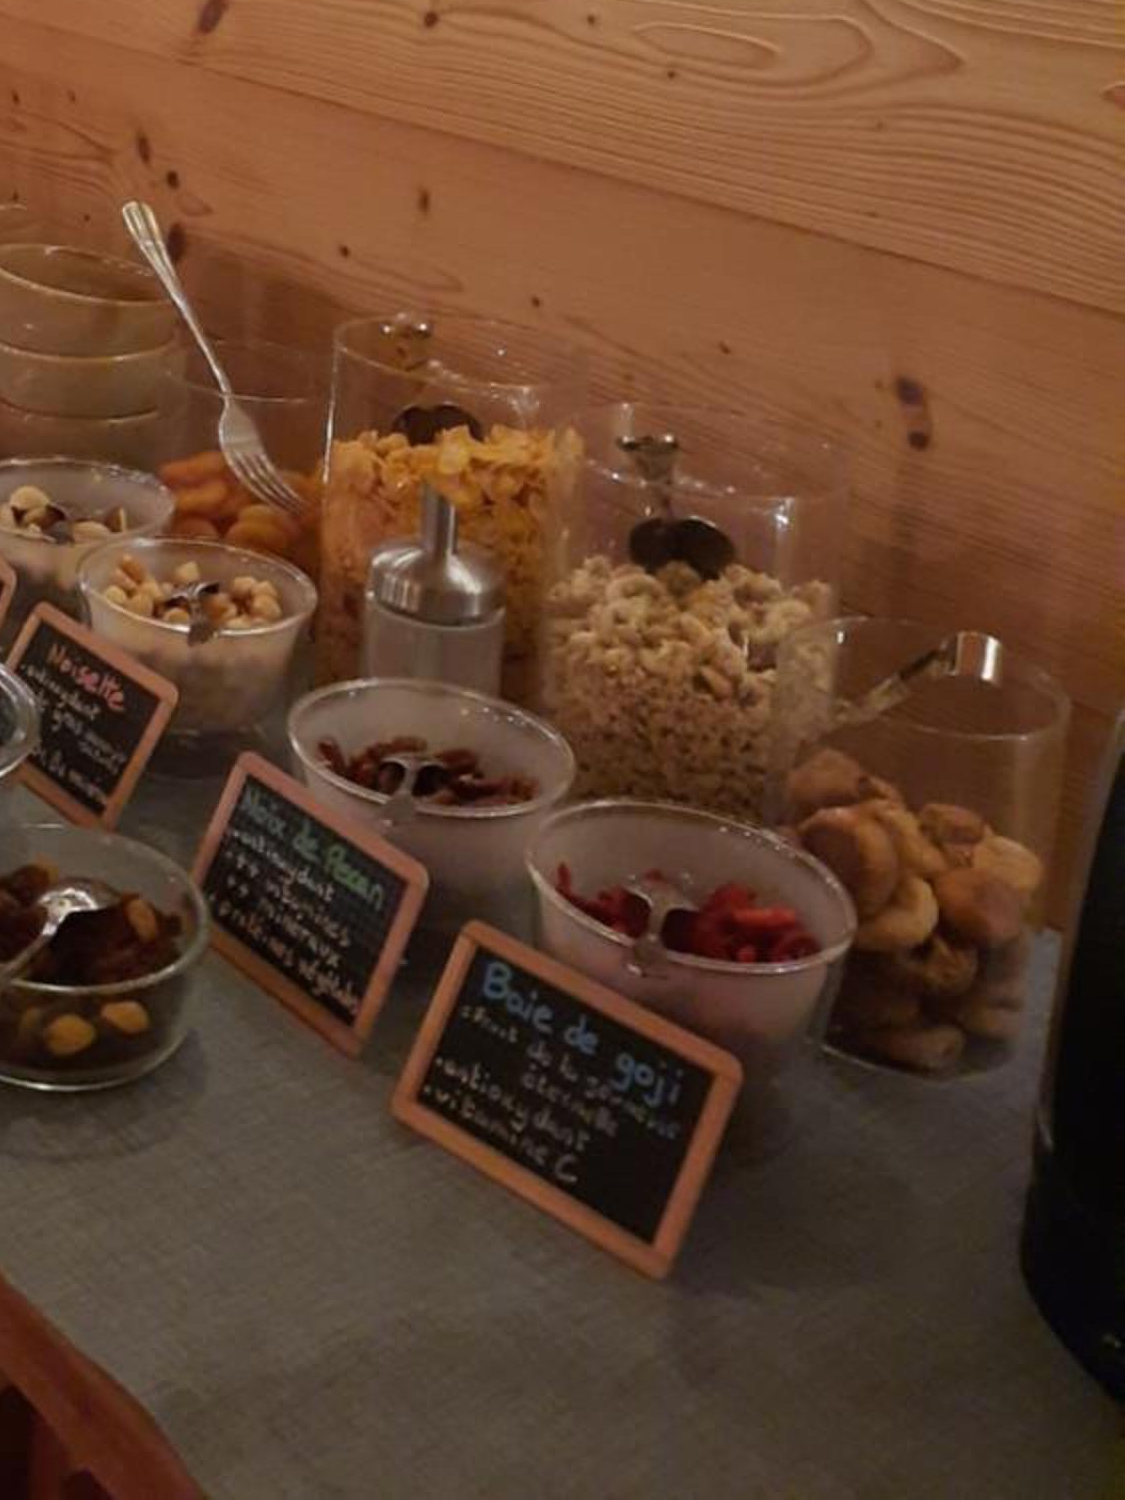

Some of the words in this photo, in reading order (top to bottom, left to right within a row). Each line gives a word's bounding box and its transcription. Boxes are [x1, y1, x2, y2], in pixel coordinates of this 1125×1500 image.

[482, 961, 552, 1033] Baie
[564, 1015, 598, 1054] de
[615, 1053, 683, 1106] goji
[435, 1092, 547, 1165] vitamine
[555, 1154, 577, 1182] C
